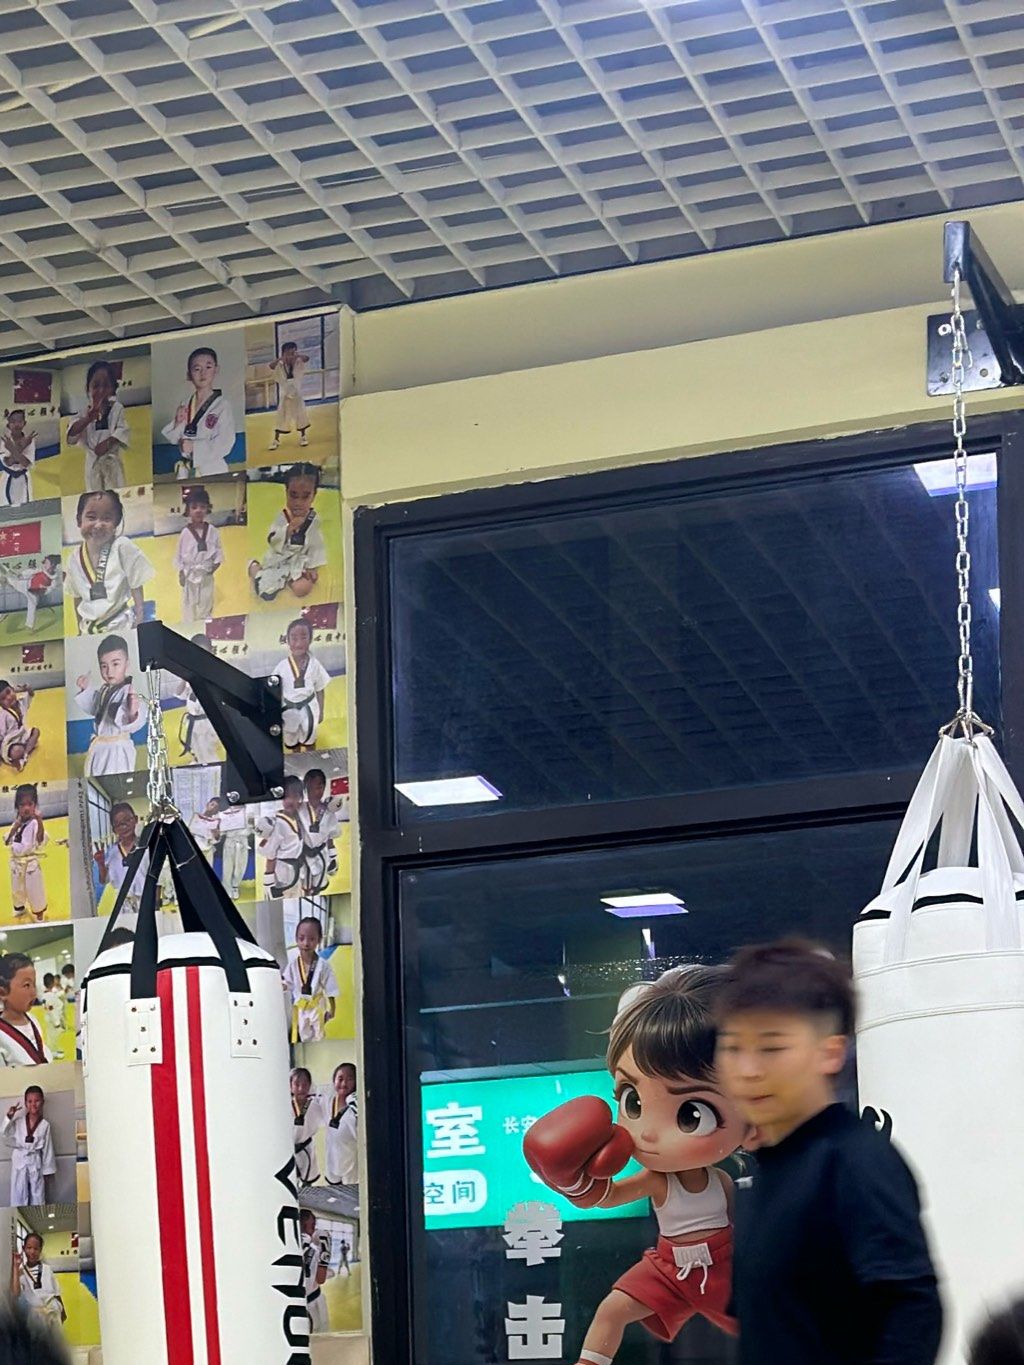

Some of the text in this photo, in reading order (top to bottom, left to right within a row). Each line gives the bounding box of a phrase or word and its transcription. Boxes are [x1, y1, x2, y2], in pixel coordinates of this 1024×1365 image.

[425, 1102, 486, 1159] 室
[423, 1180, 476, 1205] 空间
[502, 1200, 566, 1360] 拳击
